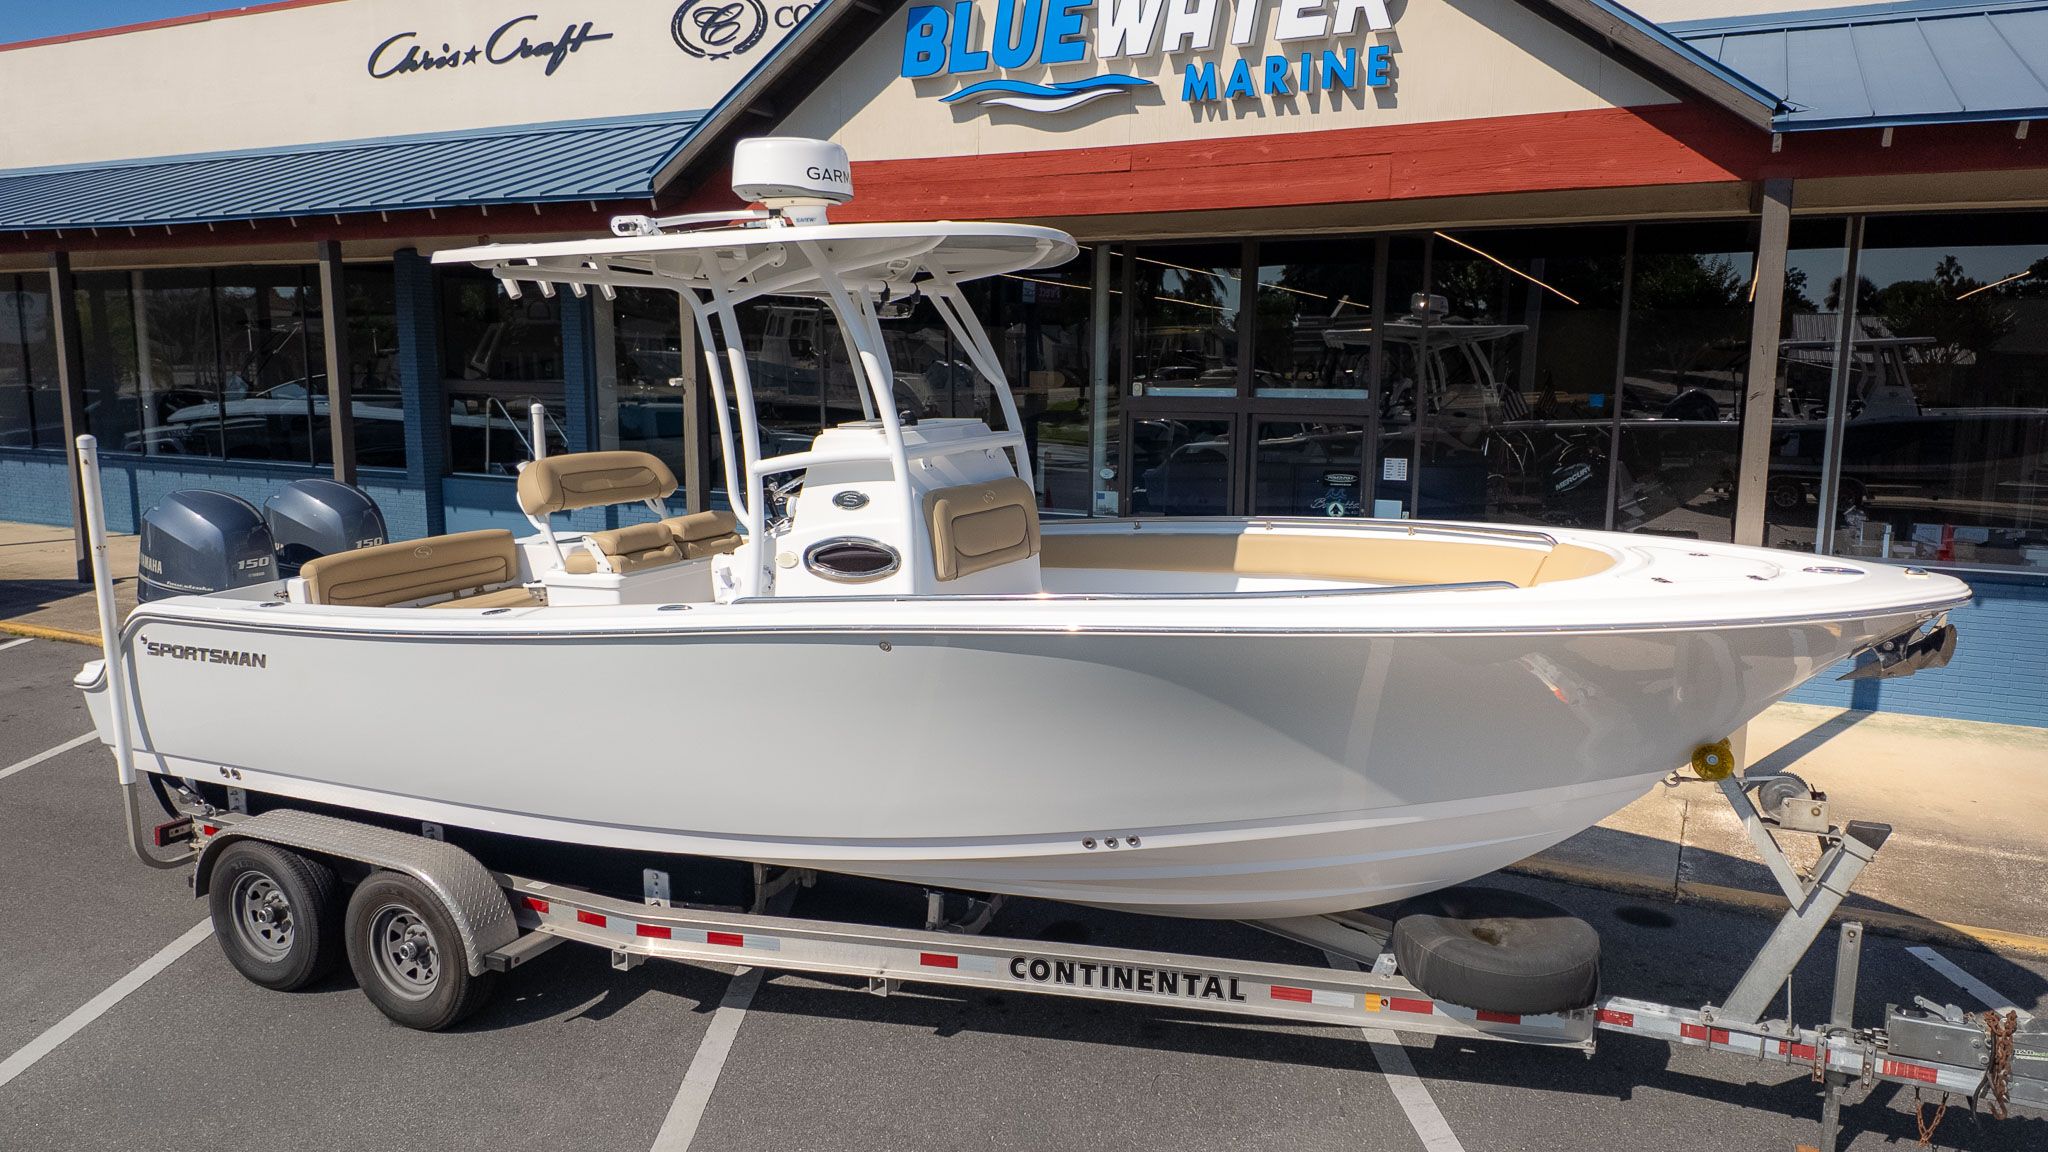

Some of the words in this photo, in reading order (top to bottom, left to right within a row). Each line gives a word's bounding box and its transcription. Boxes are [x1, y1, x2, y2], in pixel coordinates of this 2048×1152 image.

[367, 31, 461, 79] Chris
[485, 14, 613, 76] Craft
[1182, 45, 1390, 102] MARINE
[1555, 465, 1592, 491] MERCURY
[354, 537, 383, 549] 150
[140, 552, 163, 575] AMAHA
[237, 556, 271, 570] 150
[147, 641, 267, 668] SPORTSMAN
[1008, 957, 1247, 1003] CONTINENTAL
